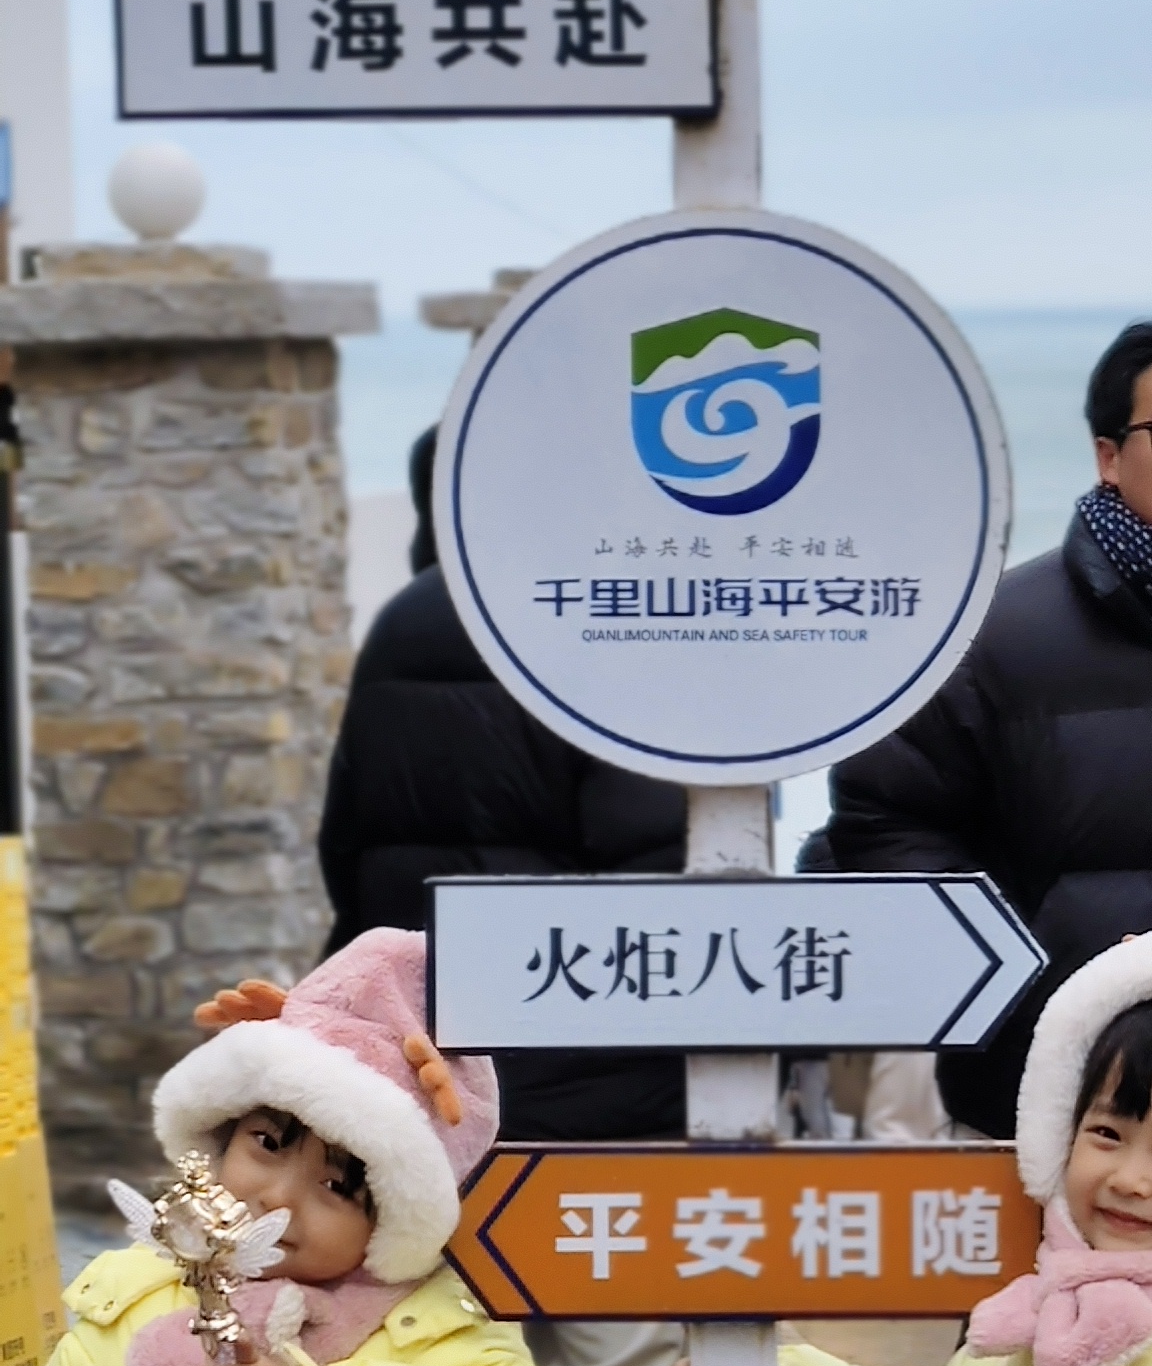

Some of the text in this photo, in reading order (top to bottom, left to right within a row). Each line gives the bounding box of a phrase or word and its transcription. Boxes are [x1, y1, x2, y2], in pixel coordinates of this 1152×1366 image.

[594, 536, 712, 559] 山海共赴
[533, 577, 922, 618] 千里山海平安游
[582, 629, 868, 643] QIANLIMOUNTAIN AND SEA SAFETY TOUR
[521, 926, 852, 1003] 火炬八街
[554, 1187, 1004, 1281] 平安相随
